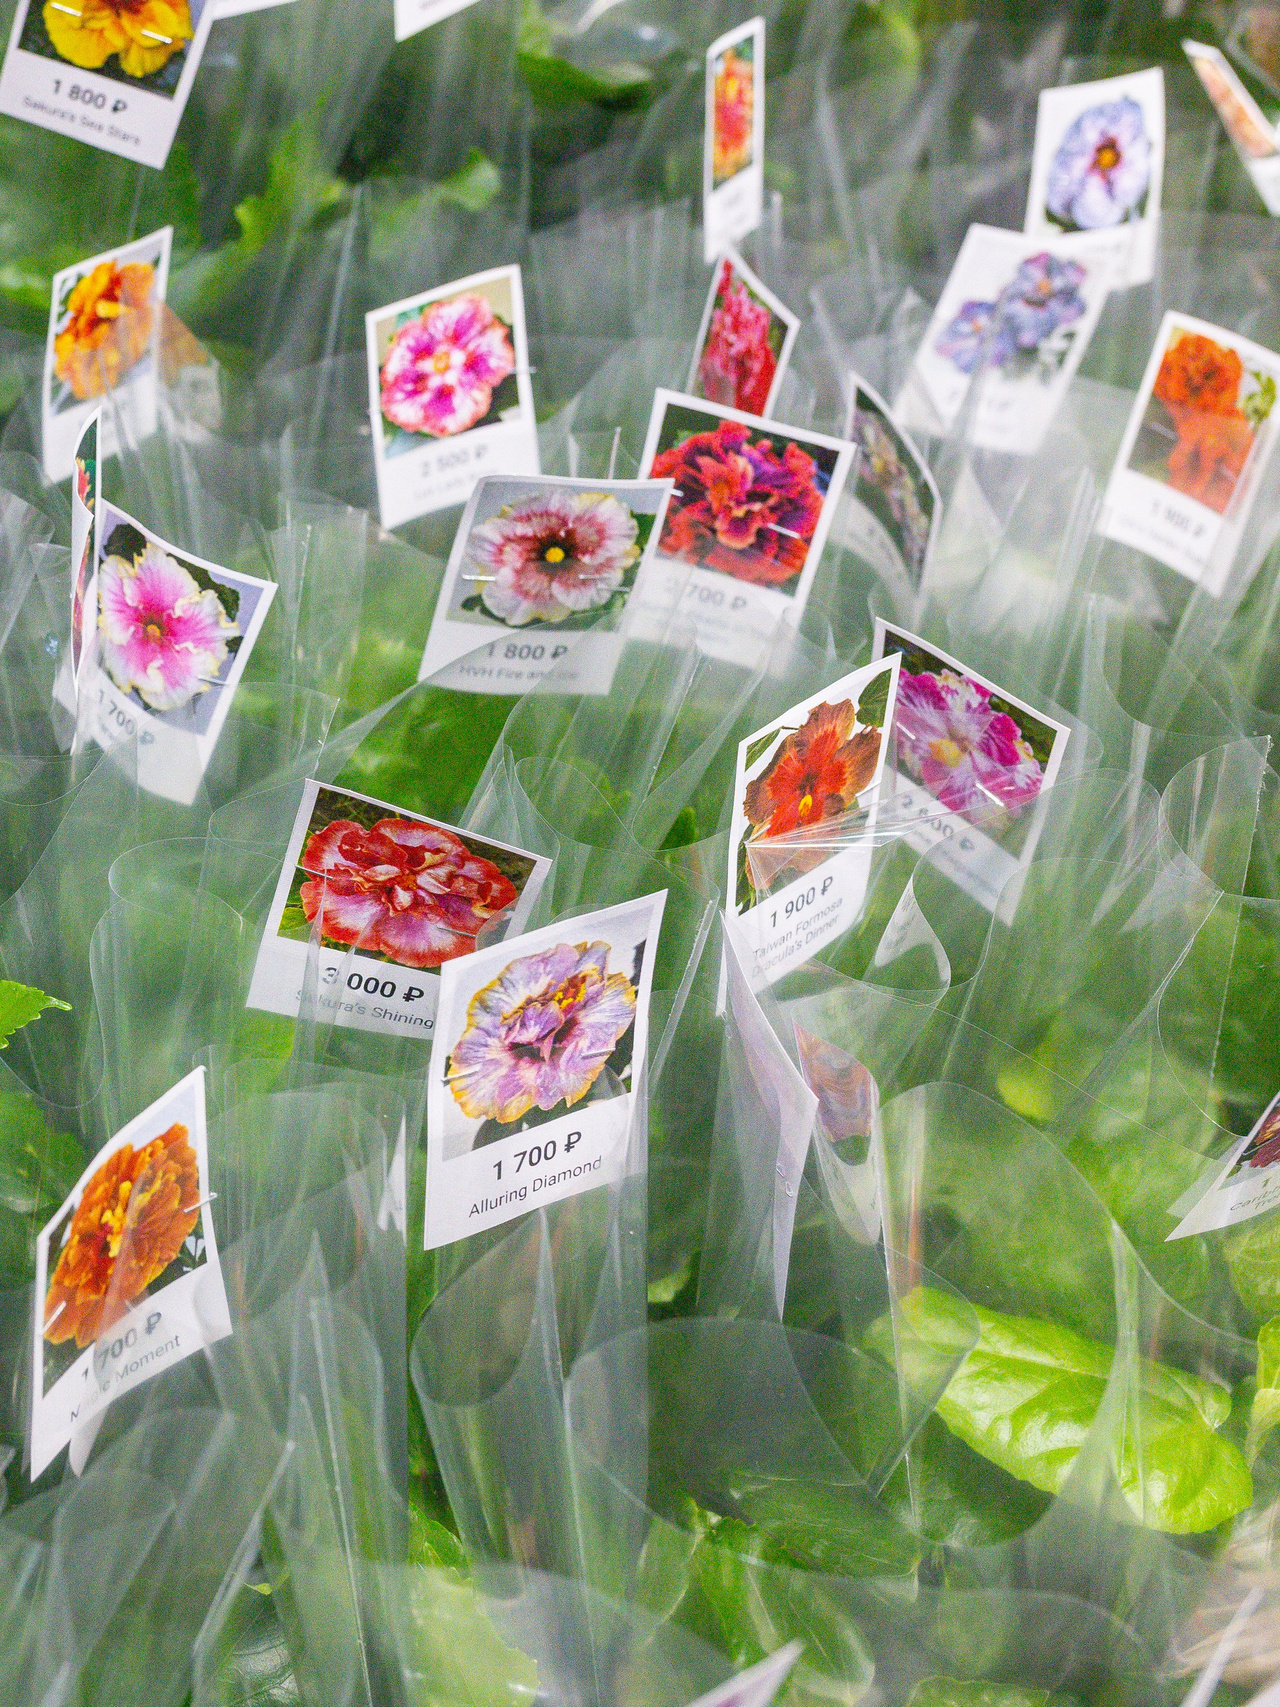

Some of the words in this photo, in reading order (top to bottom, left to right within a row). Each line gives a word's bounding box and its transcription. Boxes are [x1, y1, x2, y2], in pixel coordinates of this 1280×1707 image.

[53, 78, 62, 94] 1
[69, 84, 107, 110] 800
[504, 643, 545, 660] 800
[770, 910, 778, 928] 1
[785, 886, 816, 920] 900
[820, 875, 834, 896] ₽
[753, 930, 793, 961] Taiwan
[795, 897, 843, 936] Formosa
[805, 914, 839, 945] Dinner
[322, 967, 340, 985] 3
[346, 972, 397, 998] 000
[402, 986, 425, 1003] ₽
[371, 1006, 434, 1030] Shining
[493, 1160, 502, 1181] 1
[513, 1140, 557, 1173] 700
[564, 1131, 582, 1153] ₽
[469, 1186, 527, 1218] Alluring
[532, 1155, 602, 1193] Diamond
[99, 1328, 137, 1369] 700
[145, 1312, 162, 1335] ₽
[115, 1334, 180, 1382] Moment
